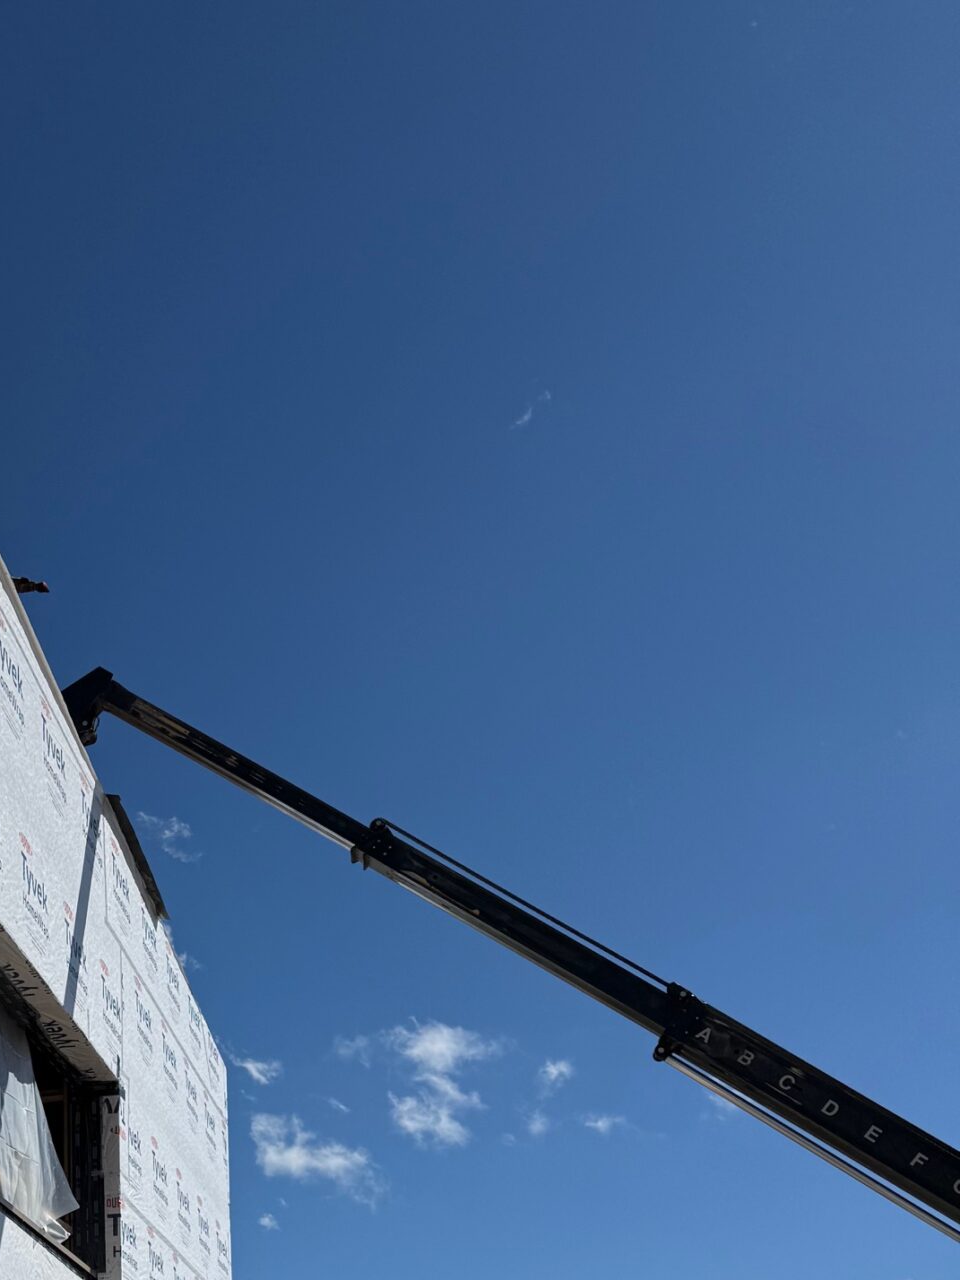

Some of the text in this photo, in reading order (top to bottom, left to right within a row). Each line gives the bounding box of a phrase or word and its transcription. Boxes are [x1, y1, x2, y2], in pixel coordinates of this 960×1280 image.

[41, 713, 66, 780] Tyvek
[21, 850, 48, 914] Tyvek
[695, 1027, 928, 1168] A B C D E F
